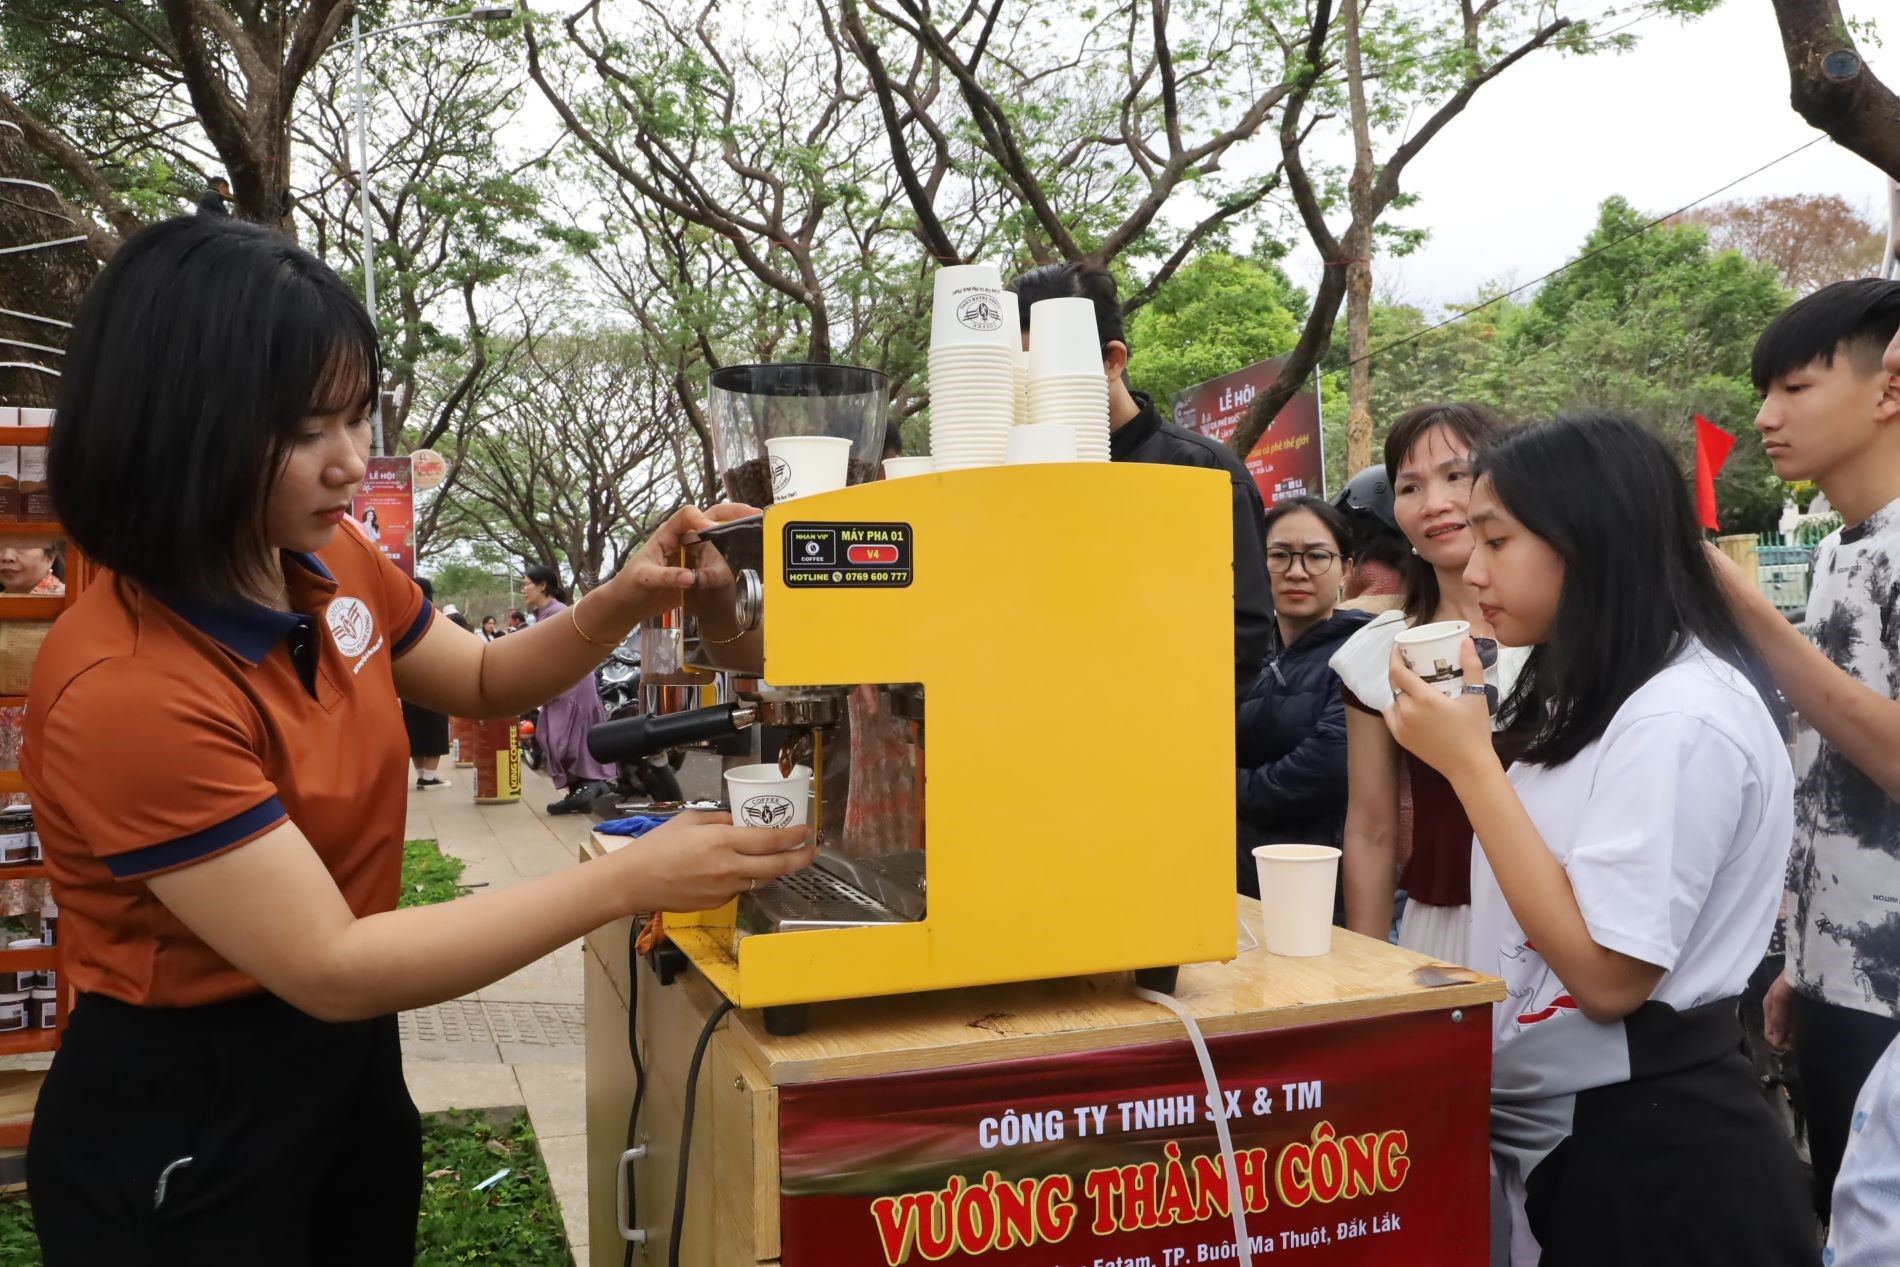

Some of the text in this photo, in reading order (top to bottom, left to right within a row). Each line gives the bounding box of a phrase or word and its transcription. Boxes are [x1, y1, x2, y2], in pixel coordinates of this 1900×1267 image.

[841, 528, 904, 541] MÁY PHA 01
[866, 549, 880, 559] V4
[845, 572, 869, 581] 0769
[870, 572, 889, 581] 600
[891, 572, 908, 581] 777
[510, 725, 518, 789] KING COFFEE
[979, 1109, 1065, 1149] CÔNG
[1073, 1105, 1109, 1137] TY
[1117, 1095, 1195, 1132] TNHH
[1252, 1086, 1273, 1116] &
[1282, 1080, 1322, 1111] TM
[871, 1120, 1410, 1267] VƯƠNG THÀNH CÔNG
[1162, 1247, 1190, 1266] TP.
[1249, 1236, 1274, 1255] Ma
[1280, 1226, 1332, 1250] Thuột,
[1337, 1217, 1367, 1241] Đắk
[1373, 1211, 1401, 1234] Lắk
